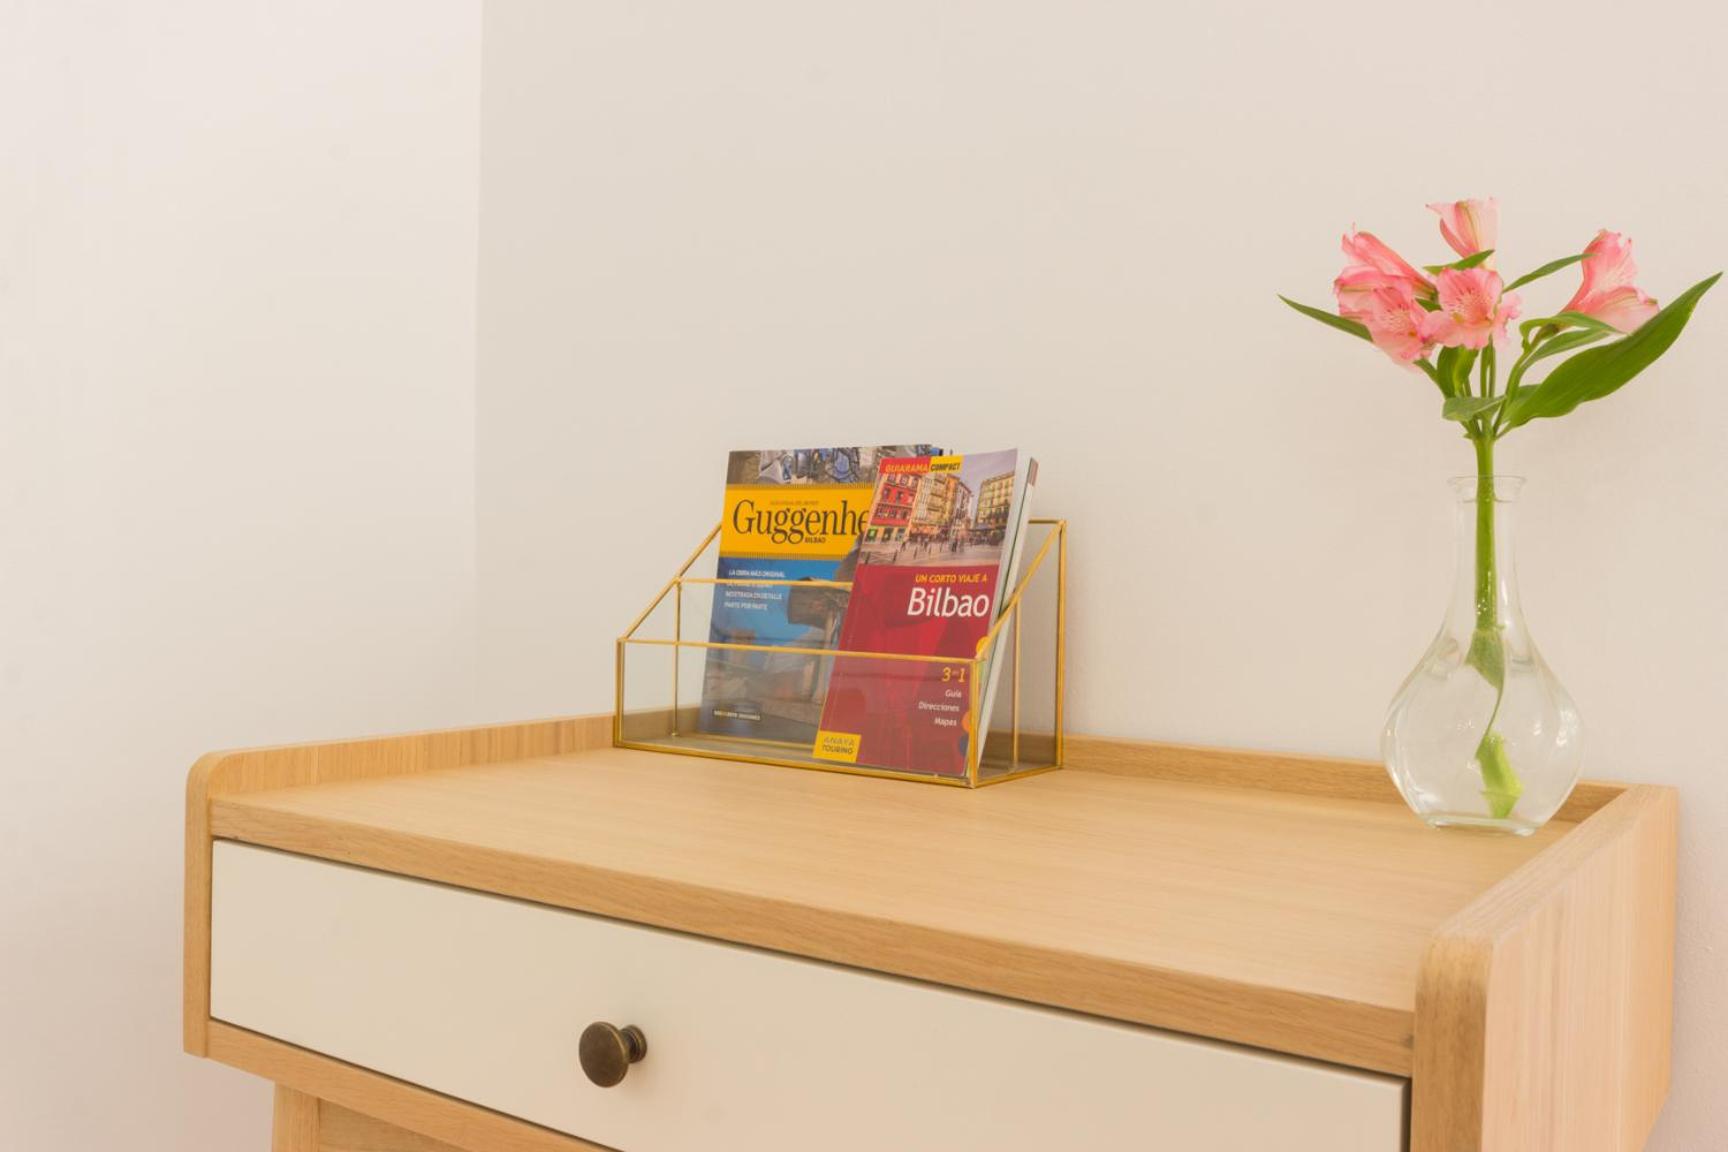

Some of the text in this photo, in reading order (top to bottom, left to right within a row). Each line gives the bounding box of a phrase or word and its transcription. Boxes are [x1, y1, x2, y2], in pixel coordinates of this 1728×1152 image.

[915, 572, 988, 583] UN CORTO VIAJE A
[907, 586, 990, 618] Bilbao
[918, 701, 960, 712] Direcciones
[934, 717, 957, 728] Mapas
[823, 745, 854, 755] TOURING
